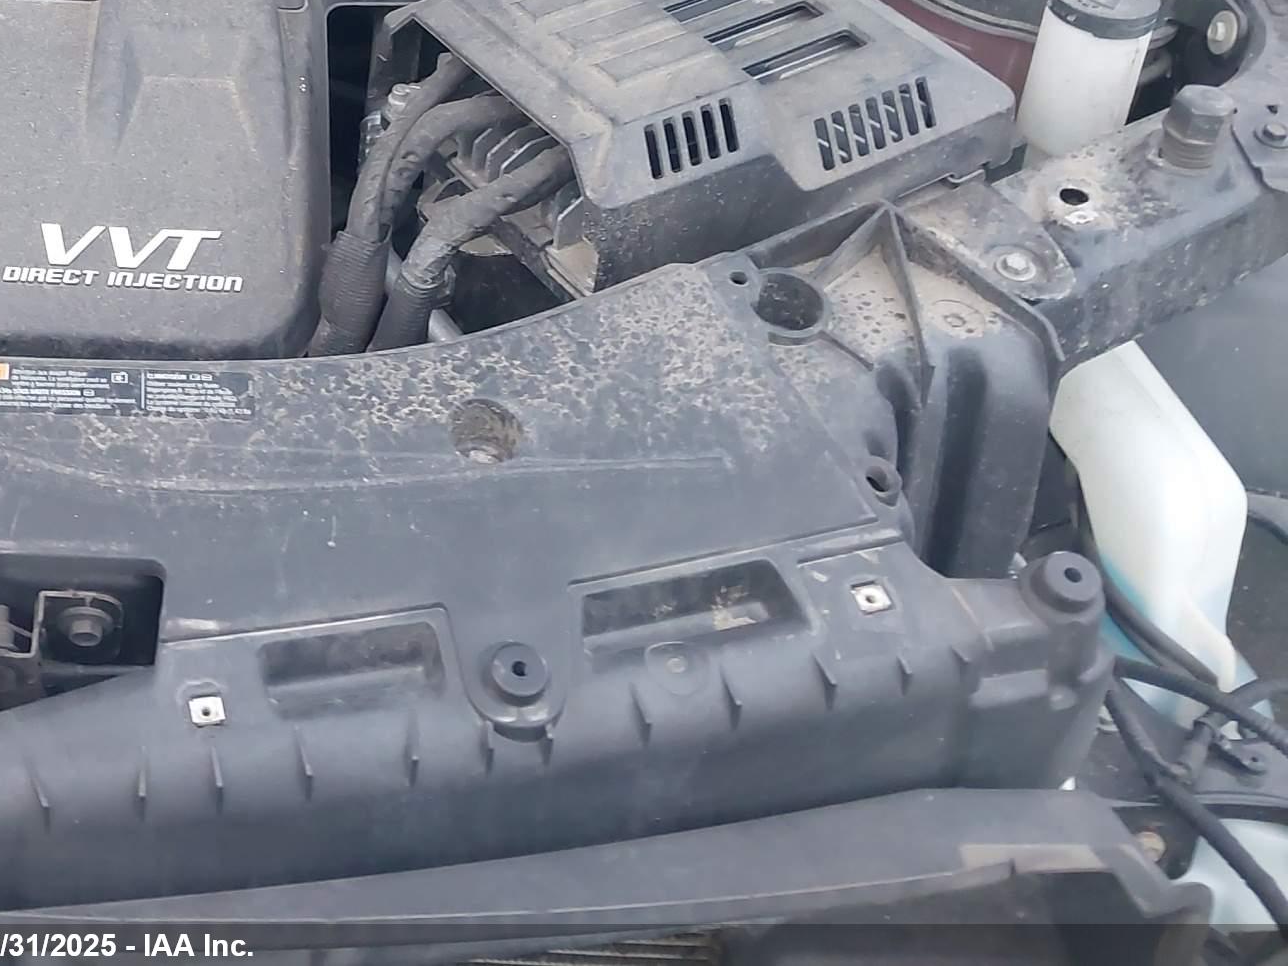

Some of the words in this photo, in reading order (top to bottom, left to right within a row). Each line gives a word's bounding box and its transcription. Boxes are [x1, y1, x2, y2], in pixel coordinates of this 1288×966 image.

[41, 223, 222, 270] VVT
[2, 265, 100, 286] DIRECT
[106, 269, 243, 293] INJECTION
